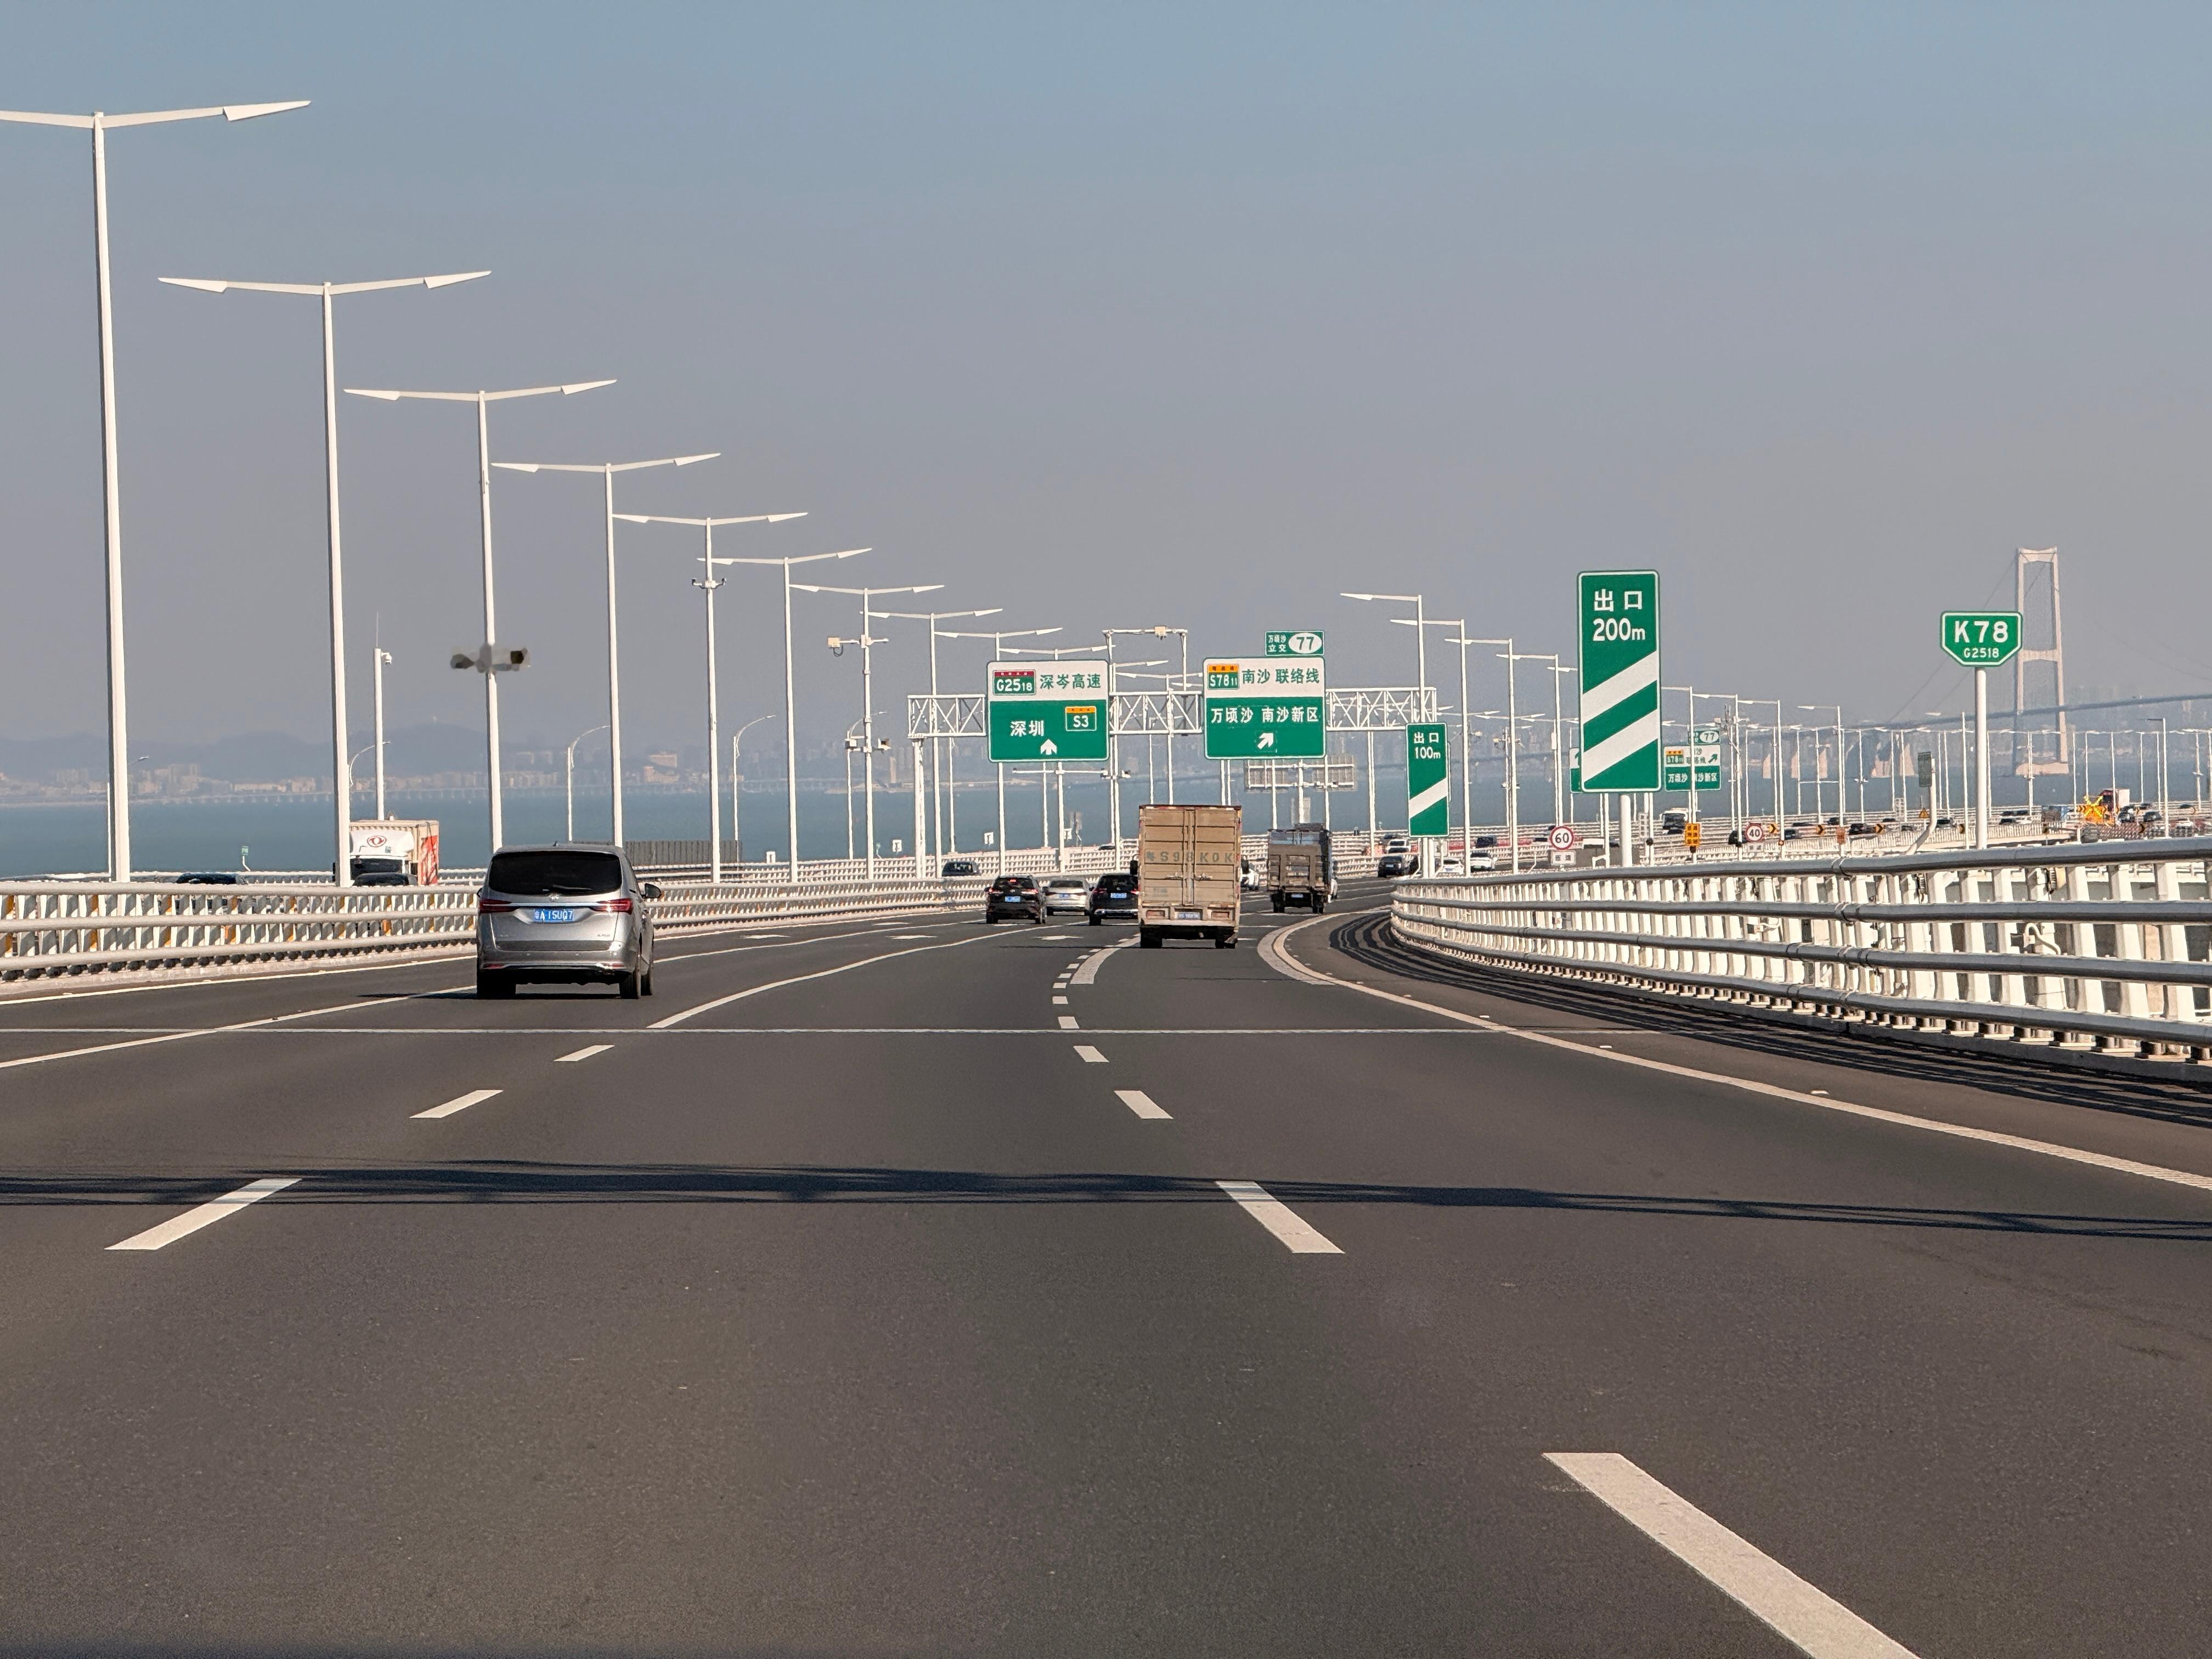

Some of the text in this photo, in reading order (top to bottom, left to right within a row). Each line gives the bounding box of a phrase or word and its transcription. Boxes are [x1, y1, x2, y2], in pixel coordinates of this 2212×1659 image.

[1594, 589, 1642, 612] 出口
[1593, 618, 1646, 641] 200m
[1954, 620, 2008, 643] K78
[1268, 644, 1286, 652] 立交
[1296, 636, 1314, 650] 77
[1963, 647, 2000, 658] G2518
[996, 678, 1032, 691] G2518
[1040, 673, 1102, 690] 深岑高速
[1210, 674, 1238, 687] S7811
[1073, 715, 1089, 727] S3
[1211, 707, 1319, 724] 万顷沙 南沙新区
[1009, 720, 1045, 737] 深圳
[1414, 732, 1439, 744] 出口
[1703, 732, 1715, 741] 77
[1415, 746, 1441, 759] 100m
[1555, 833, 1570, 843] 60
[1750, 829, 1760, 837] 40
